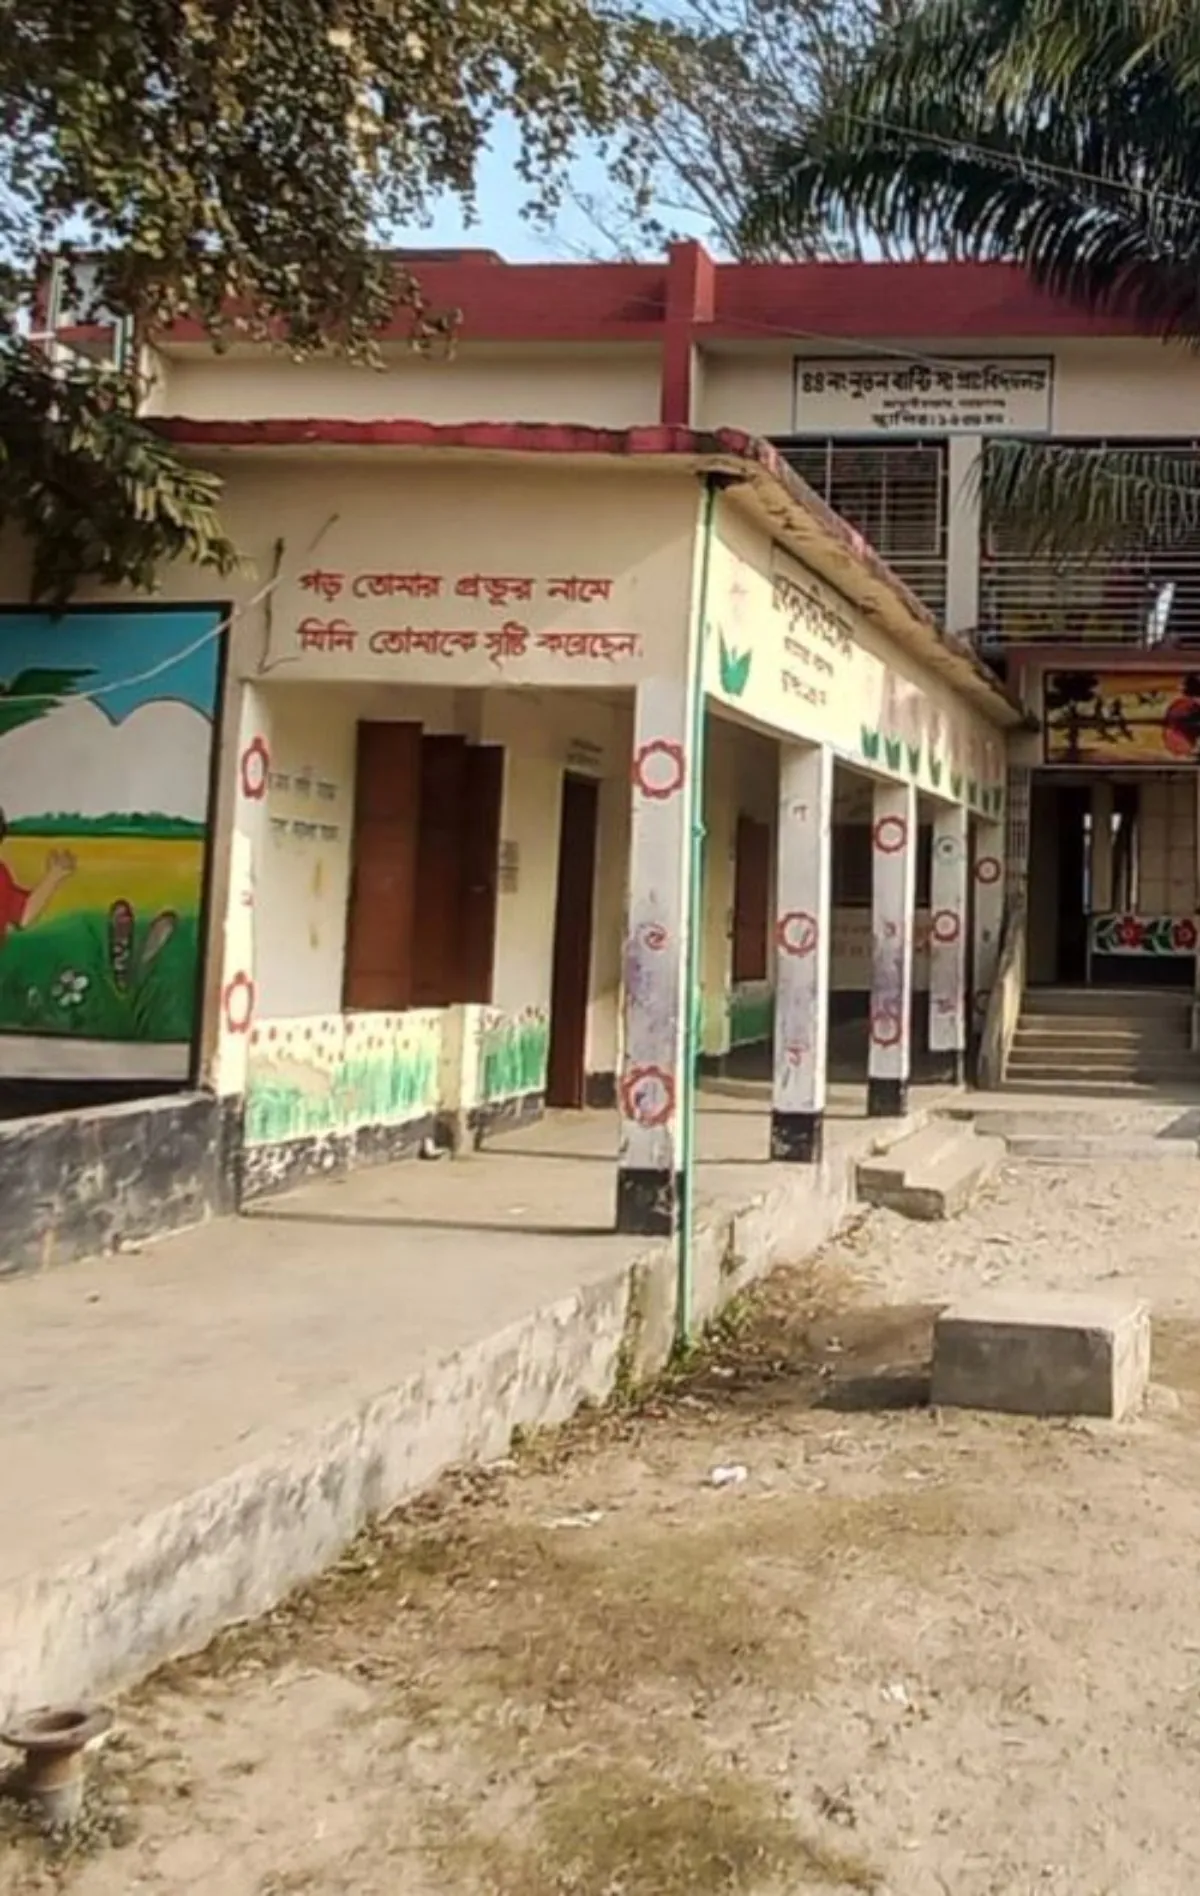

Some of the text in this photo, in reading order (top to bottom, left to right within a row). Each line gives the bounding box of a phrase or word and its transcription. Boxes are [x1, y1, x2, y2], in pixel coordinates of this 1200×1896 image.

[298, 569, 344, 602] পড়
[352, 572, 442, 598] তোমার
[546, 575, 613, 602] নামে
[297, 617, 358, 651] যিনি
[369, 627, 478, 657] তোমাকে
[484, 620, 529, 672] সৃষ্টি
